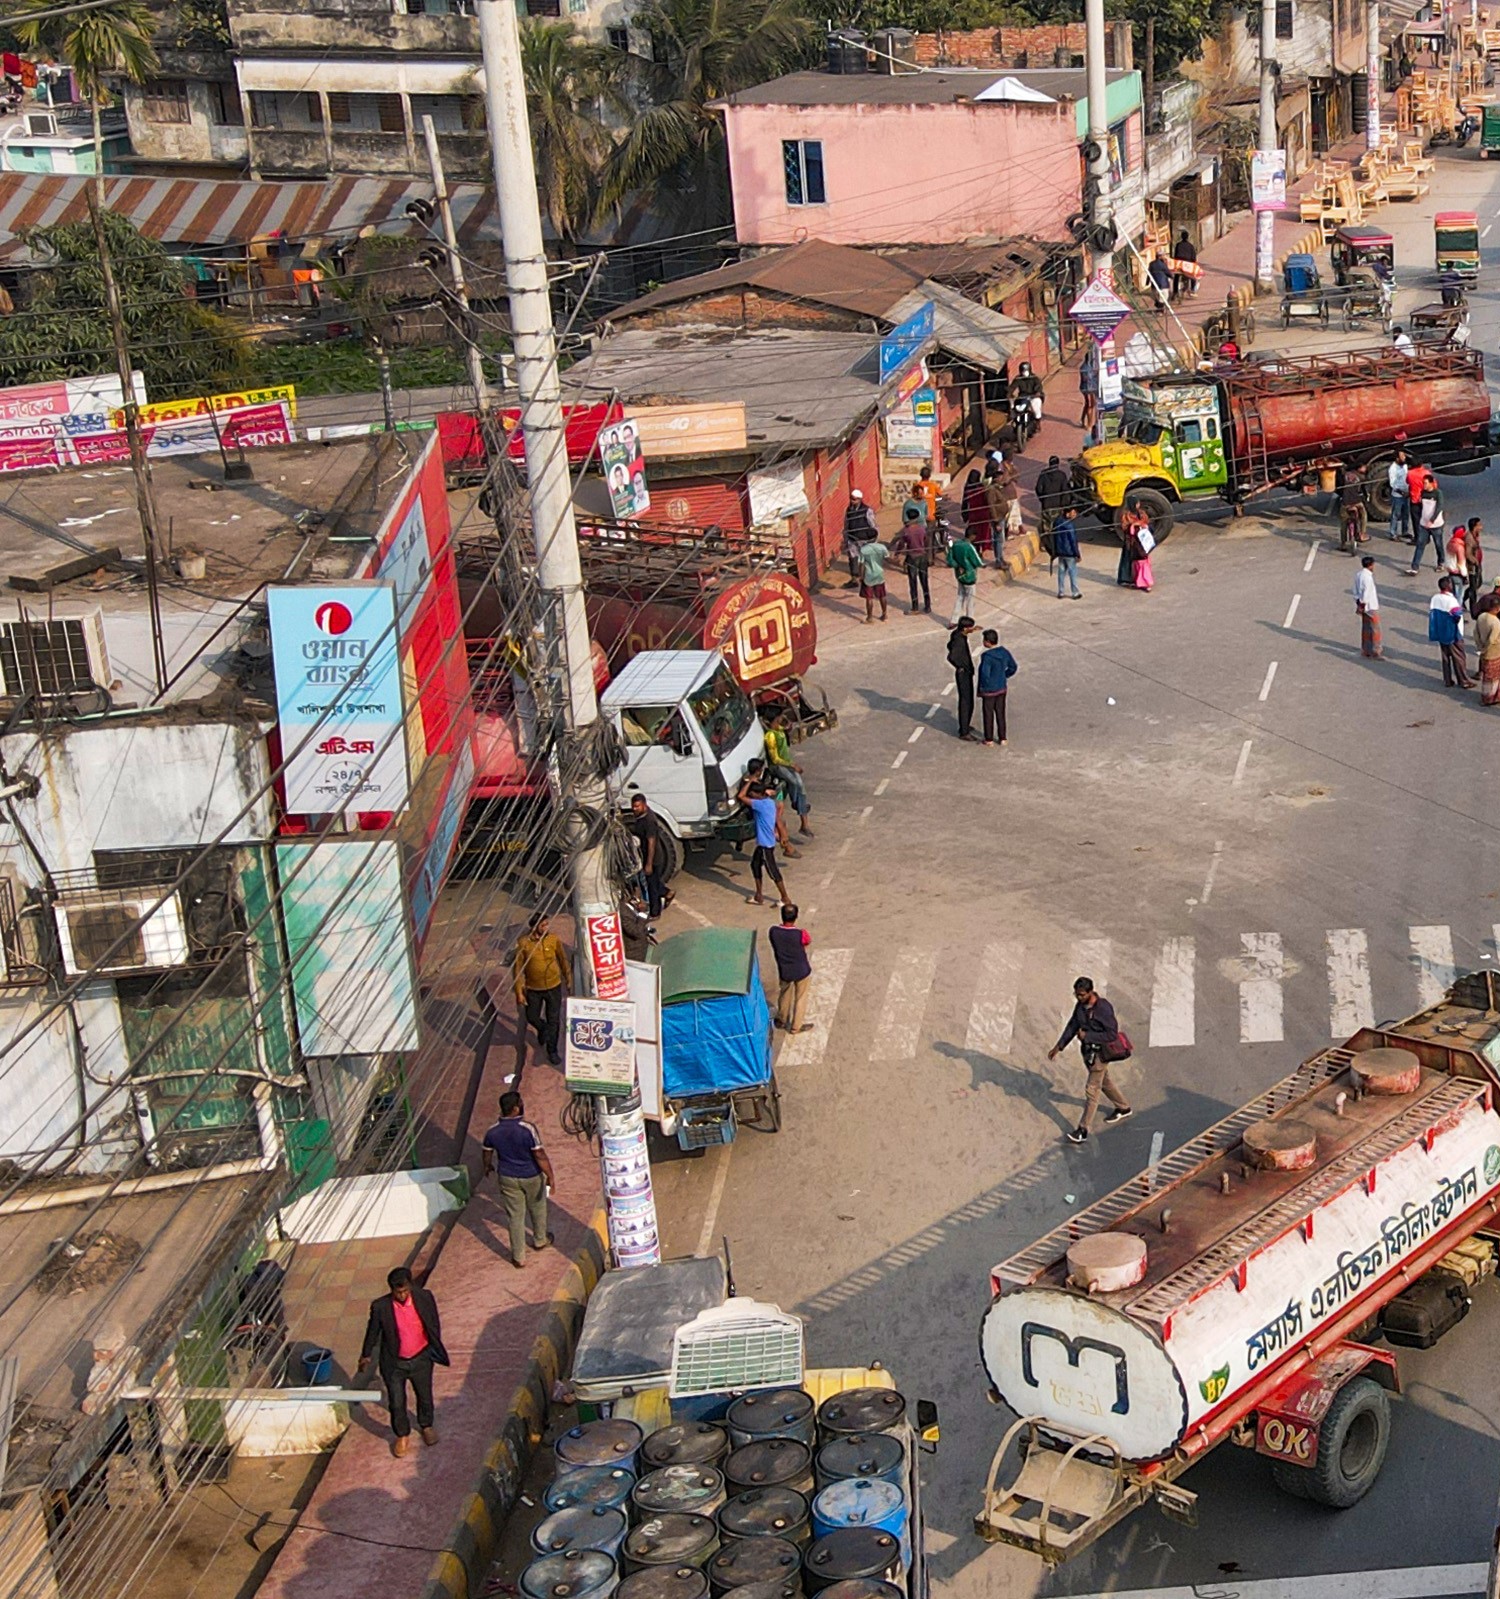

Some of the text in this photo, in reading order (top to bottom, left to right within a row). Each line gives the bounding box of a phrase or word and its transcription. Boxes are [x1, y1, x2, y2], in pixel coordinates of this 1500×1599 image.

[302, 639, 370, 663] ওয়ান
[315, 736, 375, 755] এটিএম
[332, 769, 362, 781] ২৪/৭
[1245, 1297, 1303, 1370] মেসার্স
[1380, 1201, 1431, 1264] ফিলিং
[1430, 1167, 1478, 1226] ষ্টেশন
[1205, 1377, 1227, 1404] BP
